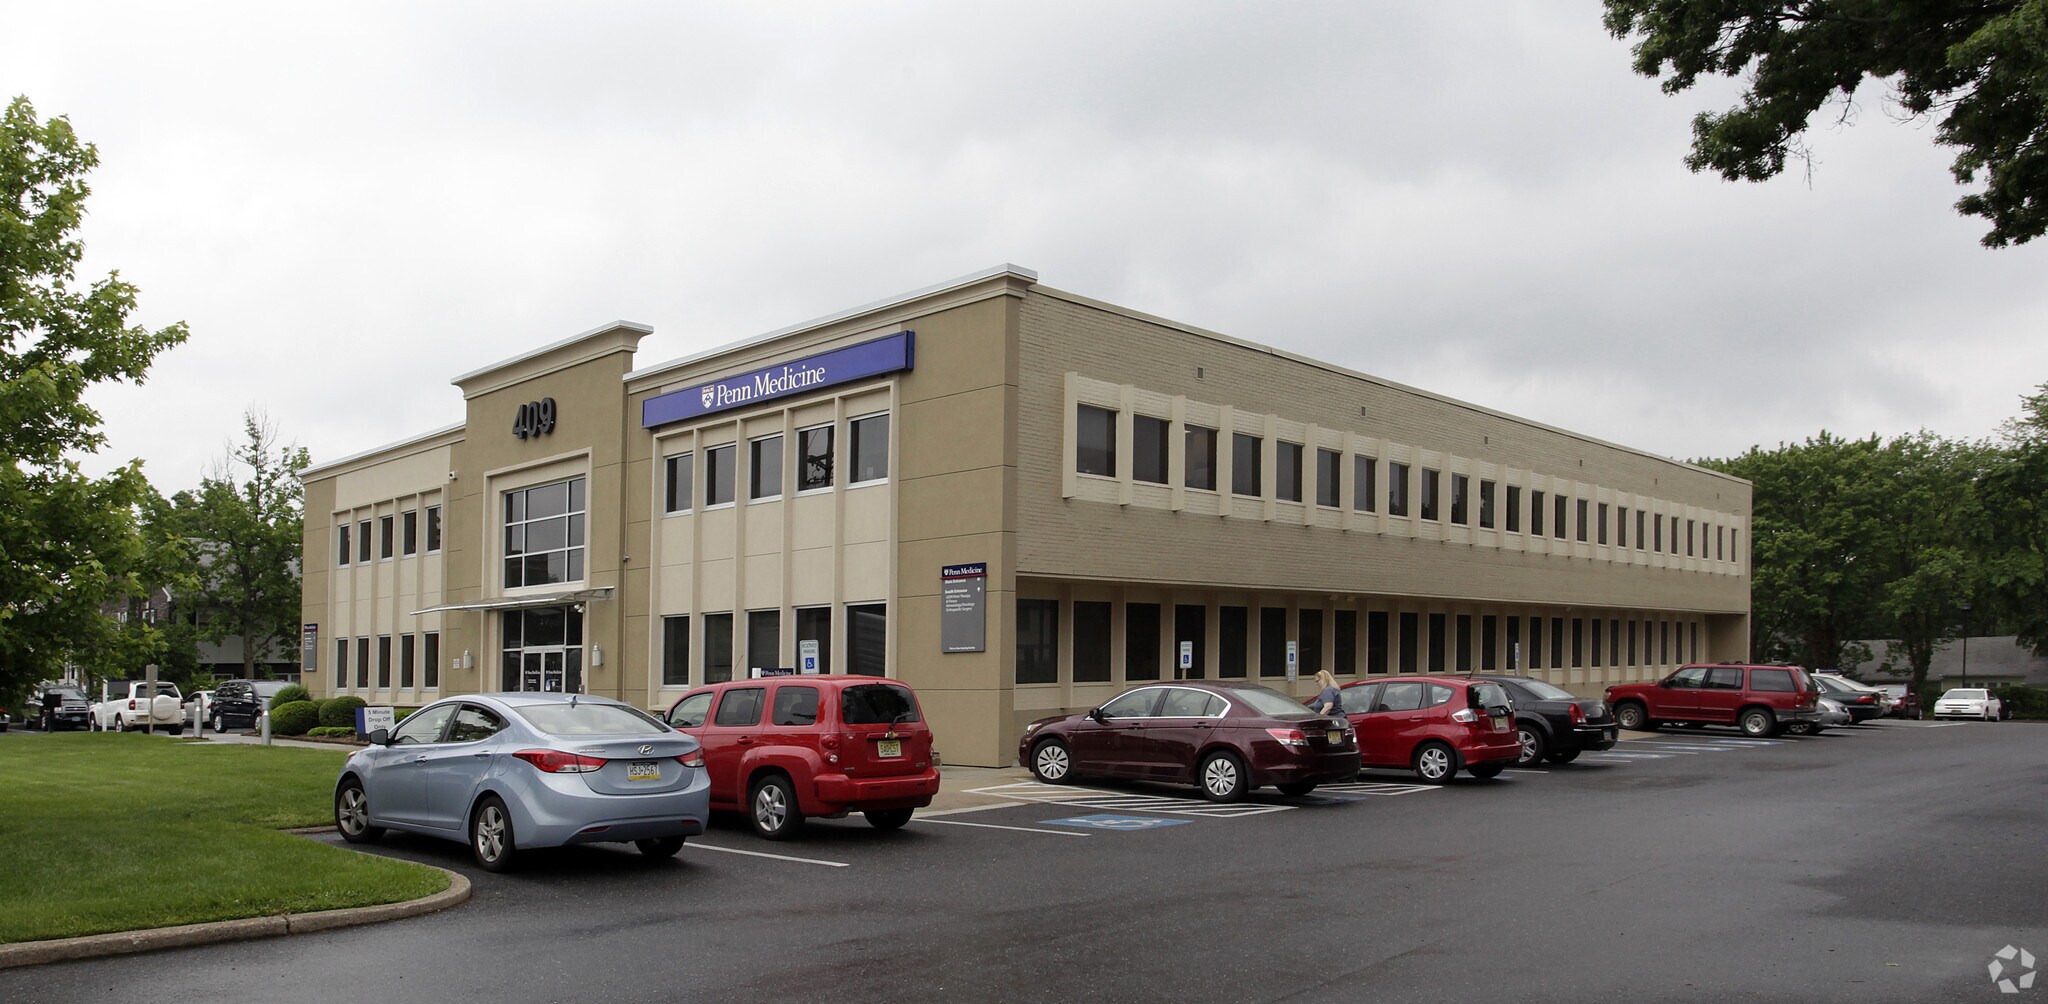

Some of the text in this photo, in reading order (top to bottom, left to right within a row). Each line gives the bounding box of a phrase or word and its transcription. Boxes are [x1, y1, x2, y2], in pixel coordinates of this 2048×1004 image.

[716, 364, 826, 406] Penn Medicine
[512, 397, 557, 440] 409
[960, 566, 983, 575] Medicine
